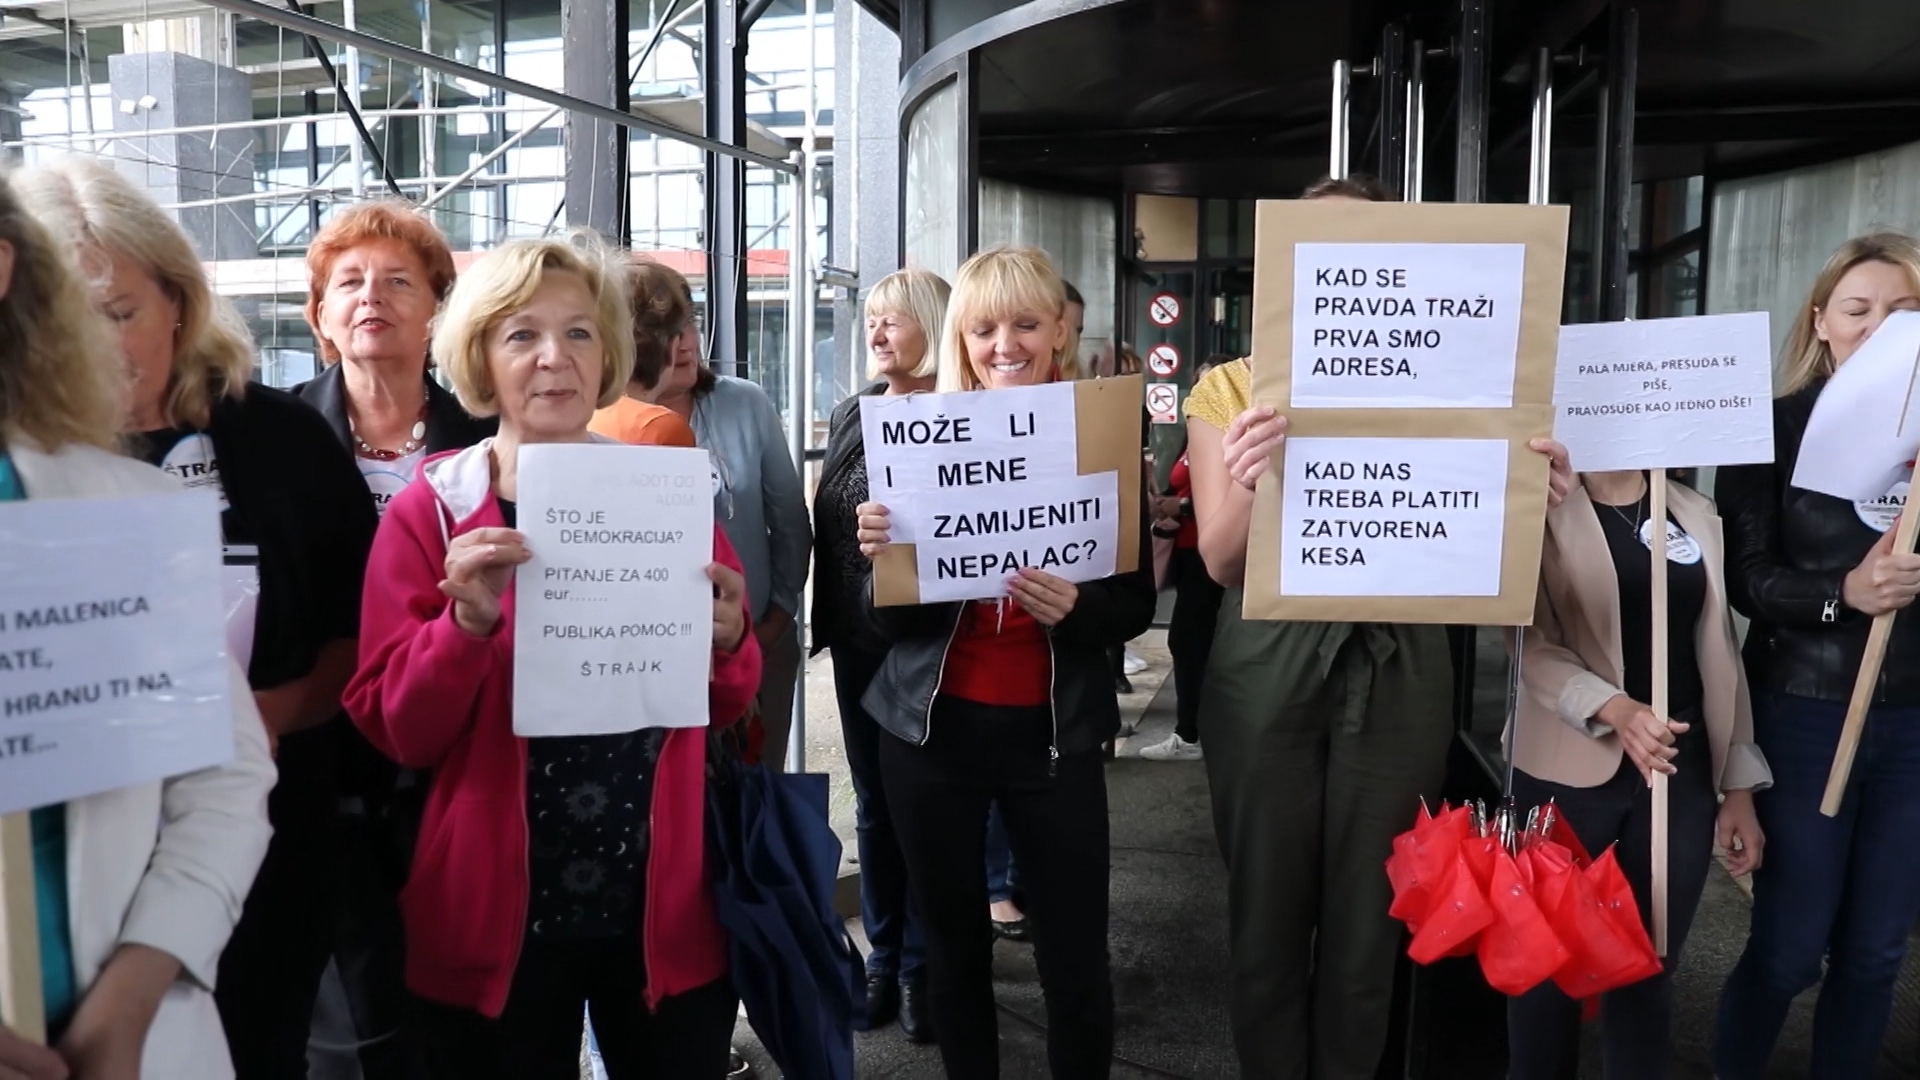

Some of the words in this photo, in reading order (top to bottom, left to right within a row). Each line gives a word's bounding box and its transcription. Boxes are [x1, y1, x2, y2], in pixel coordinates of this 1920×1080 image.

[1316, 268, 1367, 287] KAD
[1376, 269, 1407, 288] SE
[1314, 297, 1416, 317] PRAVDA
[1425, 295, 1494, 318] TRAŽI
[1313, 329, 1379, 348] PRVA
[1388, 329, 1440, 348] SMO
[1312, 357, 1418, 379] ADRESA,
[1578, 364, 1610, 376] PALA
[1612, 361, 1658, 373] MJERA,
[1661, 357, 1720, 370] PRESUDA
[1722, 355, 1737, 367] SE
[1643, 377, 1672, 391] PIŠE,
[1645, 400, 1672, 413] KAO
[1674, 399, 1716, 412] JEDNO
[1719, 395, 1752, 408] DIŠE!
[882, 413, 972, 444] MOŽE
[1010, 412, 1035, 437] LI
[886, 466, 893, 487] I
[938, 457, 1027, 487] MENE
[1305, 461, 1354, 480] KAD
[1363, 463, 1411, 480] NAS
[1304, 489, 1384, 508] TREBA
[1392, 491, 1479, 509] PLATITI
[546, 508, 581, 524] ŠTO
[586, 511, 606, 524] JE
[933, 498, 1101, 538] ZAMIJENITI
[560, 529, 684, 544] DEMOKRACIJA?
[1301, 519, 1447, 538] ZATVORENA
[937, 539, 1098, 579] NEPALAC?
[1301, 547, 1366, 566] KESA
[545, 568, 615, 582] PITANJE
[619, 569, 641, 582] ZA
[644, 568, 669, 582] 400
[15, 594, 151, 631] MALENICA
[543, 625, 616, 639] PUBLIKA
[620, 622, 677, 637] POMOĆ
[3, 682, 101, 718] HRANU
[108, 677, 130, 698] TI
[137, 671, 174, 693] NA
